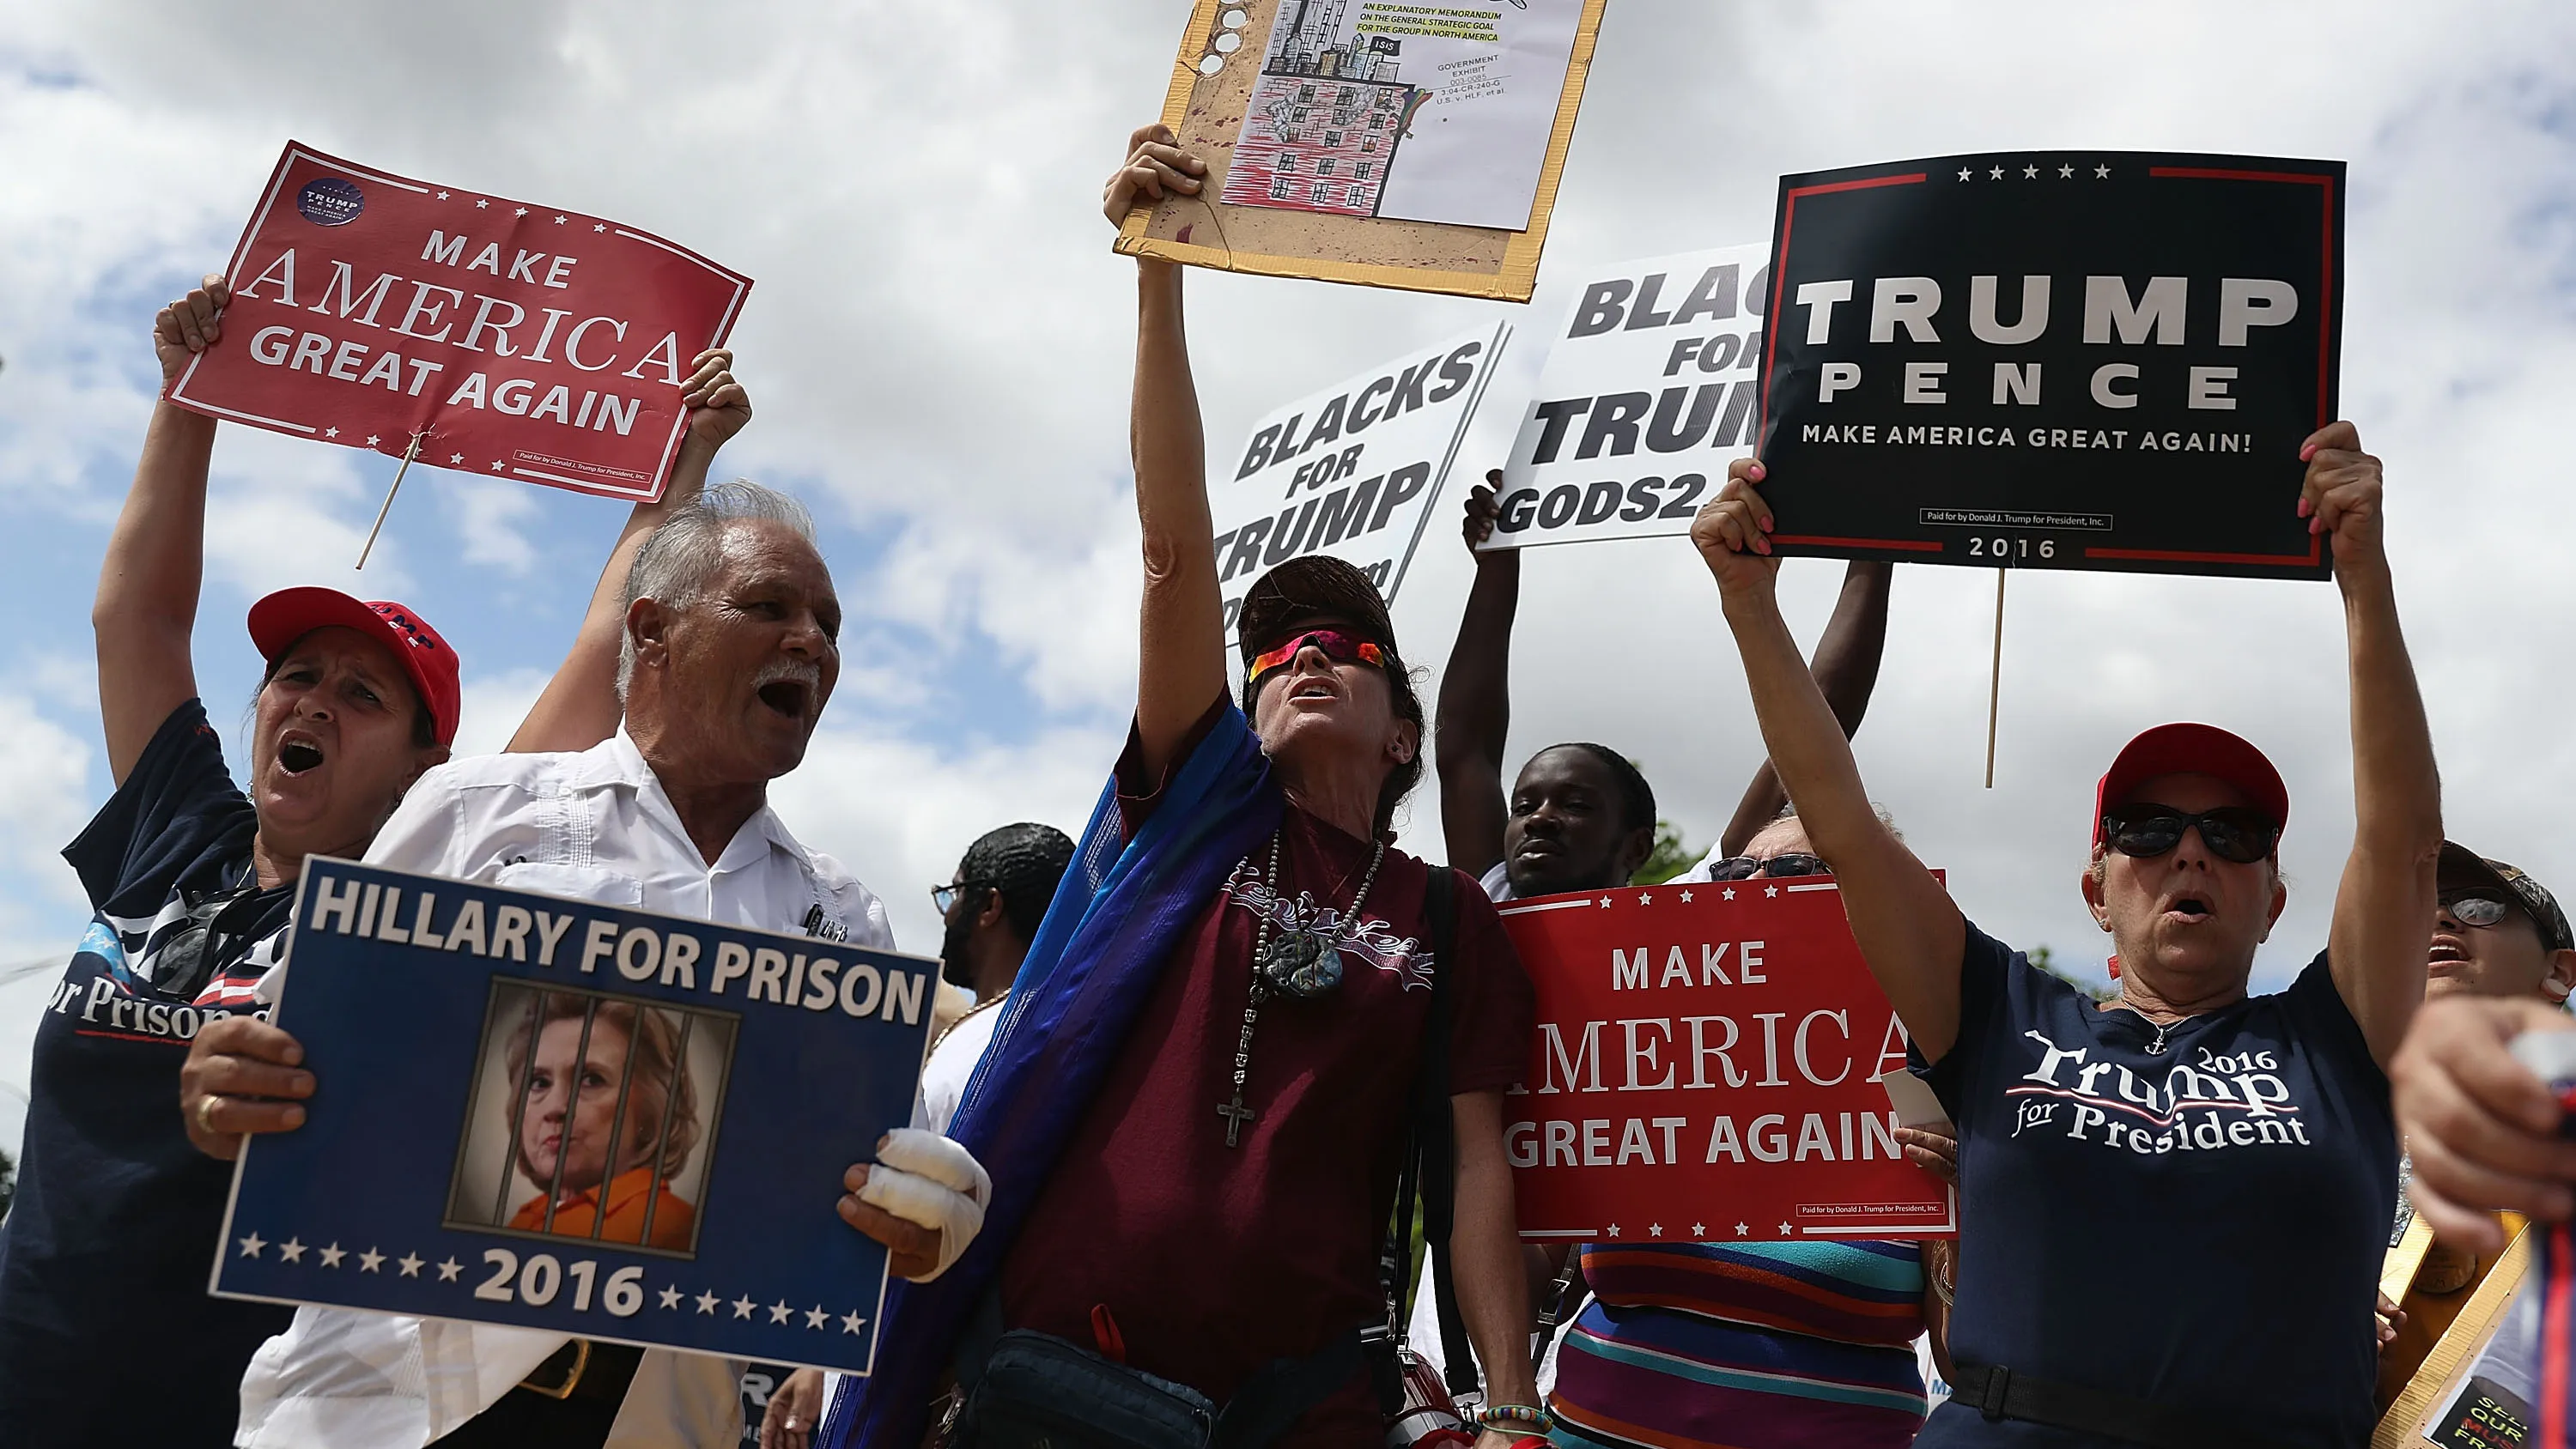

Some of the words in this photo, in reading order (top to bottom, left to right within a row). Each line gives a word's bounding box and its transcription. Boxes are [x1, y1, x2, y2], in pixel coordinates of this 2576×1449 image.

[1357, 23, 1373, 32] FOR
[1392, 27, 1421, 35] GROUP
[1431, 29, 1461, 39] NORTH
[1461, 33, 1499, 41] AMERICA
[1362, 3, 1376, 11] AN
[1376, 4, 1437, 15] EXPLANATORY
[1437, 9, 1503, 20] MEMORANDUM
[1391, 15, 1427, 26] GENERAL
[1428, 19, 1472, 29] STRATEGIC
[1437, 54, 1499, 71] GOVERNMENT
[1452, 65, 1486, 77] EXHIBIT
[307, 191, 358, 209] TRUMP
[307, 198, 350, 213] PENCE
[420, 228, 578, 290] MAKE
[236, 247, 682, 386] AMERICA
[1795, 275, 2300, 348] TRUMP
[250, 324, 443, 398] GREAT
[446, 372, 641, 436] AGAIN
[1818, 361, 2239, 410] PENCE
[1234, 341, 1482, 483] BLACKS
[1802, 424, 1877, 445] MAKE
[1886, 426, 2017, 448] AMERICA
[2028, 427, 2128, 450] GREAT
[2140, 432, 2251, 453] AGAIN!
[550, 458, 572, 468] Donald
[577, 464, 597, 473] Trump
[606, 469, 635, 479] President,
[1285, 443, 1365, 500] FOR
[1927, 512, 1944, 520] Paid
[1945, 512, 1957, 521] for
[1958, 512, 1967, 523] by
[1969, 512, 1996, 522] Donald
[1996, 514, 2003, 523] J.
[2005, 514, 2032, 524] Trump
[2032, 515, 2045, 524] for
[2046, 516, 2088, 526] President,
[2089, 518, 2104, 526] Inc.
[1969, 537, 2055, 559] 2016
[309, 876, 575, 967] HILLARY
[580, 919, 703, 990] FOR
[710, 943, 928, 1026] PRISON
[1612, 940, 1767, 991] MAKE
[1505, 1008, 1909, 1095] MERICA
[2197, 1046, 2278, 1076] 2016
[2022, 1029, 2292, 1119] Trump
[1503, 1117, 1686, 1167] GREAT
[1704, 1110, 1902, 1165] AGAIN
[2010, 1098, 2060, 1139] for
[2067, 1101, 2311, 1155] President
[1863, 1205, 1884, 1214] Trump
[474, 1247, 646, 1319] 2016
[2478, 1397, 2529, 1431] SEL
